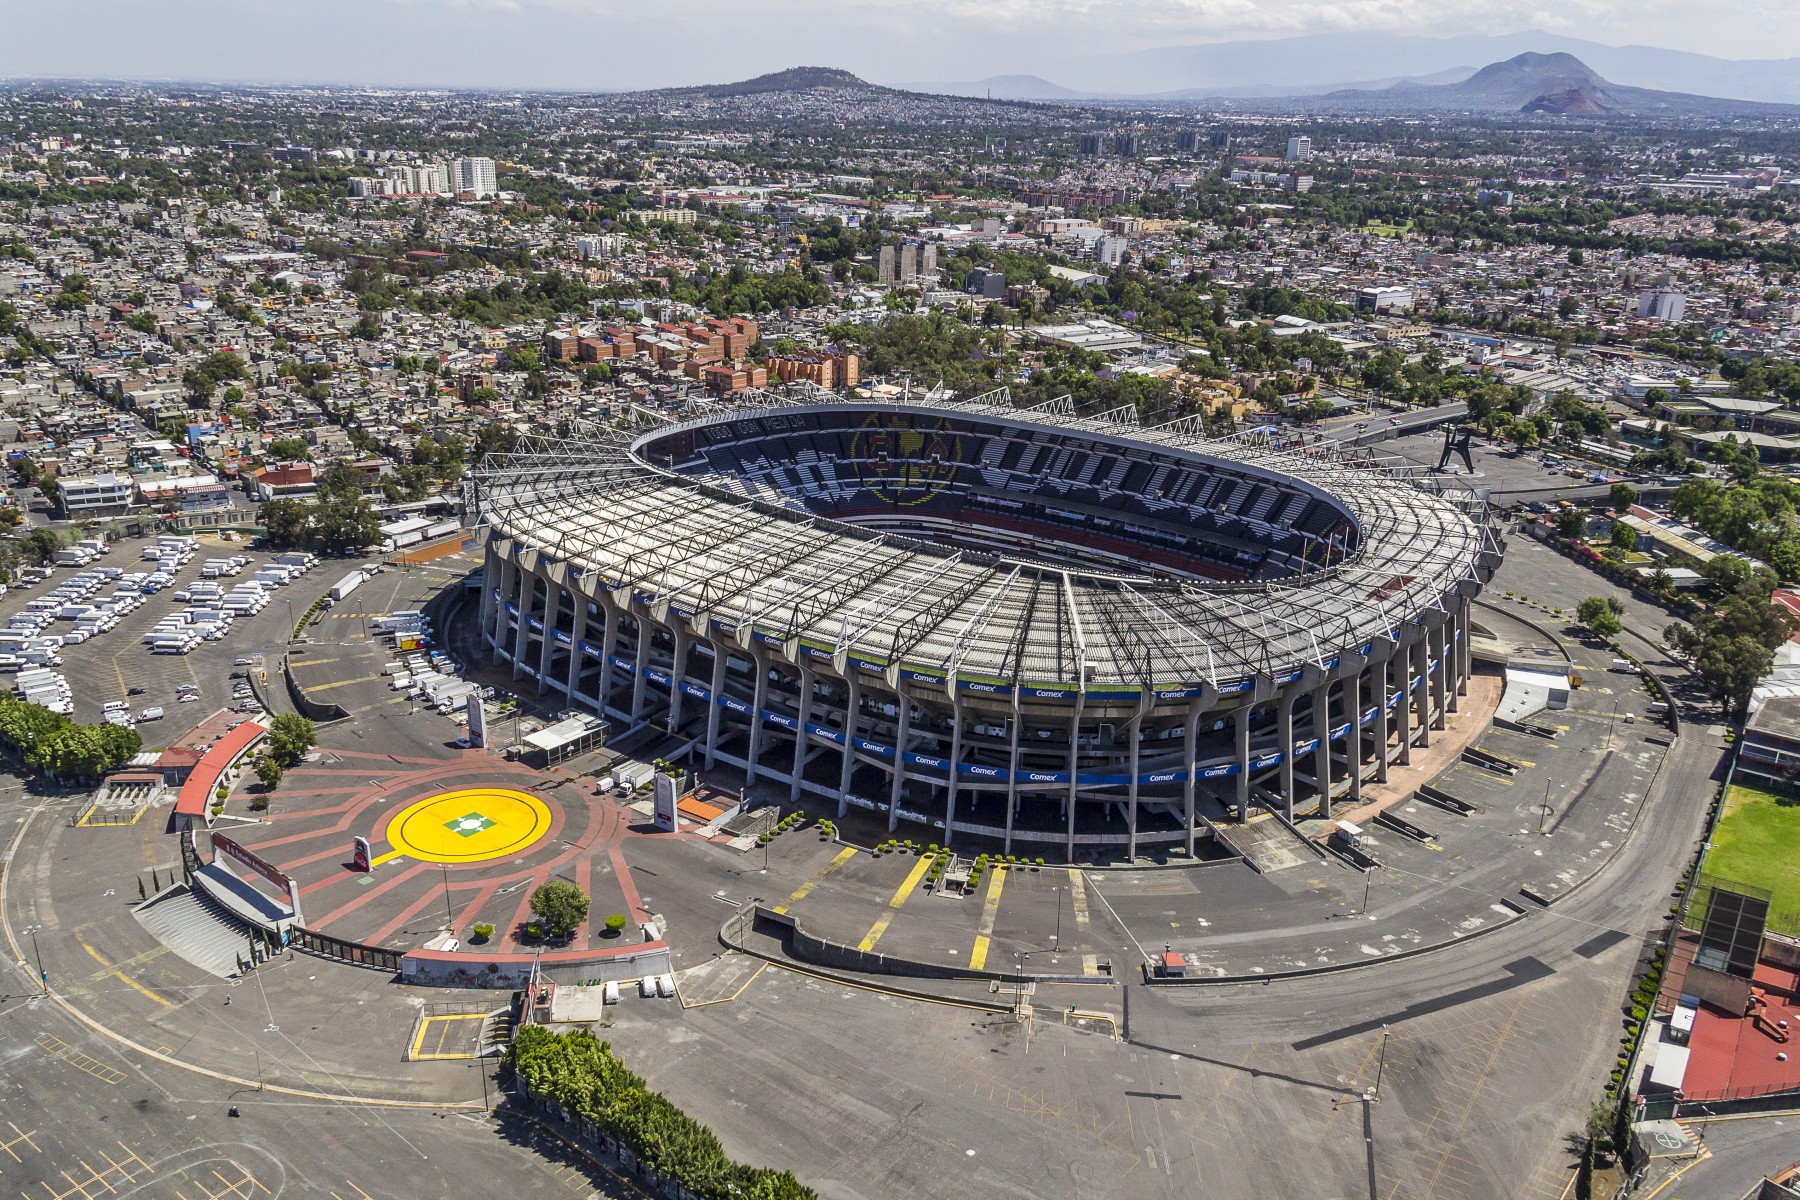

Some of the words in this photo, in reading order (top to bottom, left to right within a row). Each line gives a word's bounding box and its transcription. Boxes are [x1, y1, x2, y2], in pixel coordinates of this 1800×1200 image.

[530, 619, 543, 630] Comex
[557, 633, 572, 643] Comex
[585, 646, 600, 657] Comex
[810, 648, 833, 660] Comex
[615, 659, 632, 670] Comex
[860, 661, 884, 673] Comex
[649, 672, 667, 684] Comex
[913, 673, 939, 684] Comex
[687, 686, 705, 698] Comex
[969, 682, 996, 692] Comex
[1218, 684, 1243, 694] Comex
[1036, 690, 1064, 698] Comex
[1160, 690, 1188, 699] Comex
[727, 700, 747, 712] Comex
[770, 714, 791, 726] Comex
[815, 728, 838, 740] Comex
[862, 741, 886, 753] Comex
[1295, 743, 1313, 755] Comex
[915, 756, 941, 767] Comex
[1256, 756, 1277, 768] Comex
[971, 766, 998, 776] Comex
[1204, 767, 1229, 777] Comex
[1029, 773, 1057, 782] Comex
[1150, 773, 1176, 782] Comex
